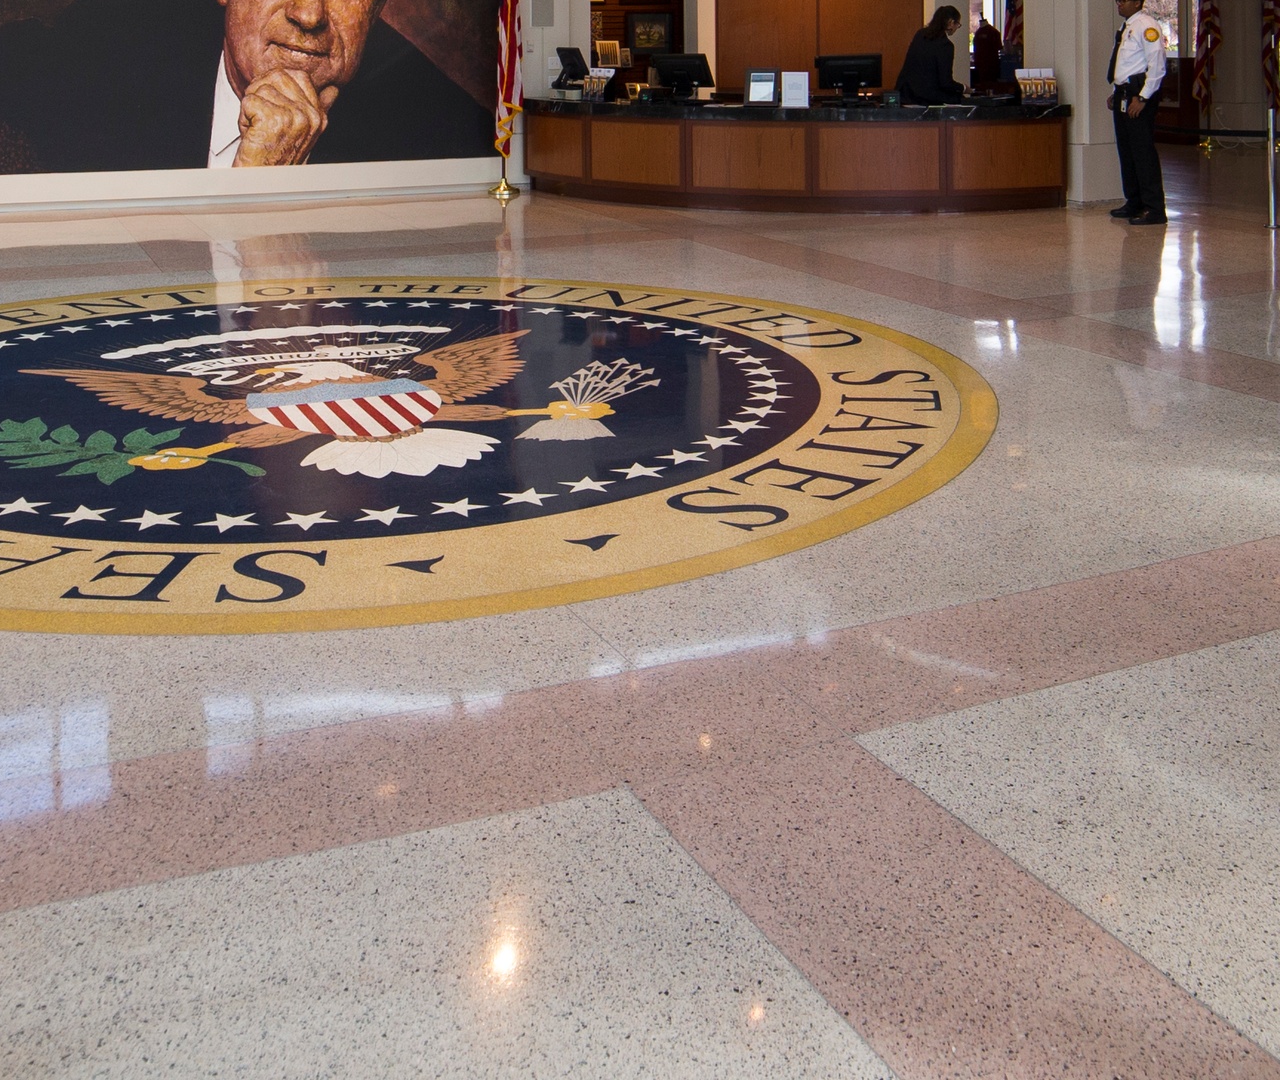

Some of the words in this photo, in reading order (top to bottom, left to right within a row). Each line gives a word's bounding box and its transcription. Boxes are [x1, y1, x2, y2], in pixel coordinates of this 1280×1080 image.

[253, 285, 336, 297] OF
[358, 284, 489, 296] THE
[506, 284, 863, 349] UNITED
[201, 351, 330, 368] PLURIBUS
[338, 346, 415, 358] UNUM
[666, 369, 943, 532] STATES
